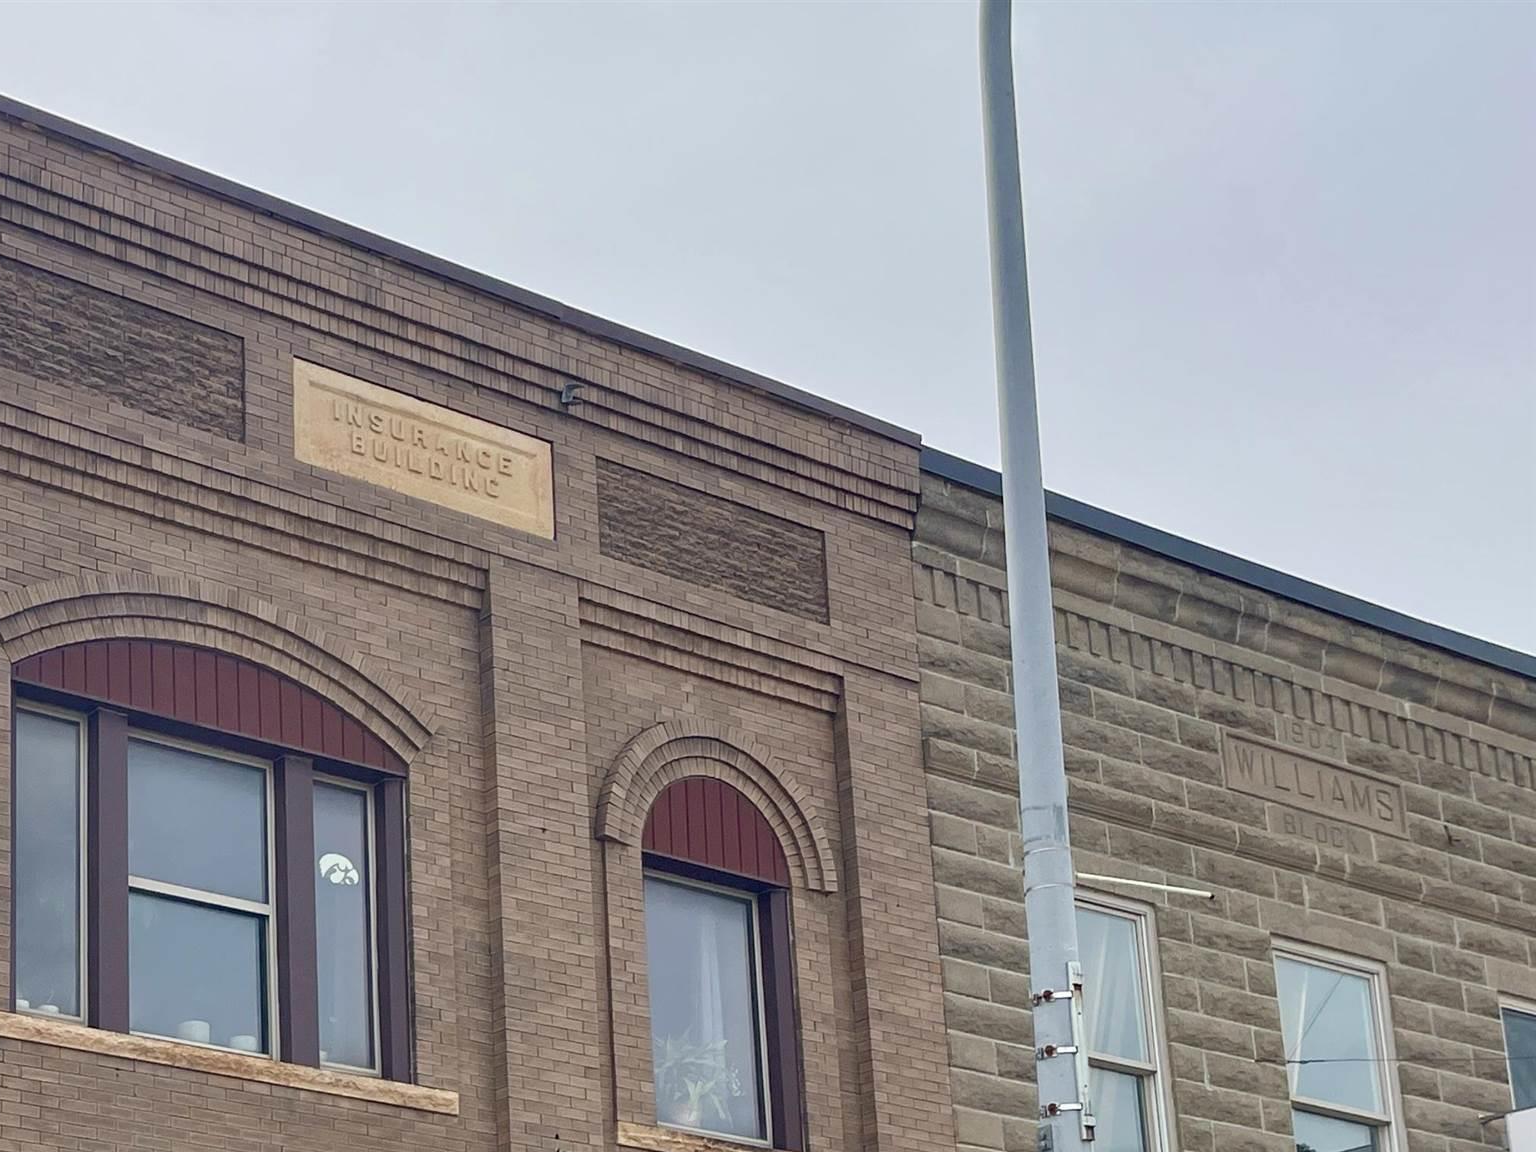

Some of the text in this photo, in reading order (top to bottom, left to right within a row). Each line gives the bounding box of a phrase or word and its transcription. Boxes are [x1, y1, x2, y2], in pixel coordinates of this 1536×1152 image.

[333, 401, 513, 477] INSURANCE
[351, 430, 500, 498] BUILDING
[1234, 745, 1394, 822] WILLIAMS
[1283, 812, 1359, 854] BLOCK
